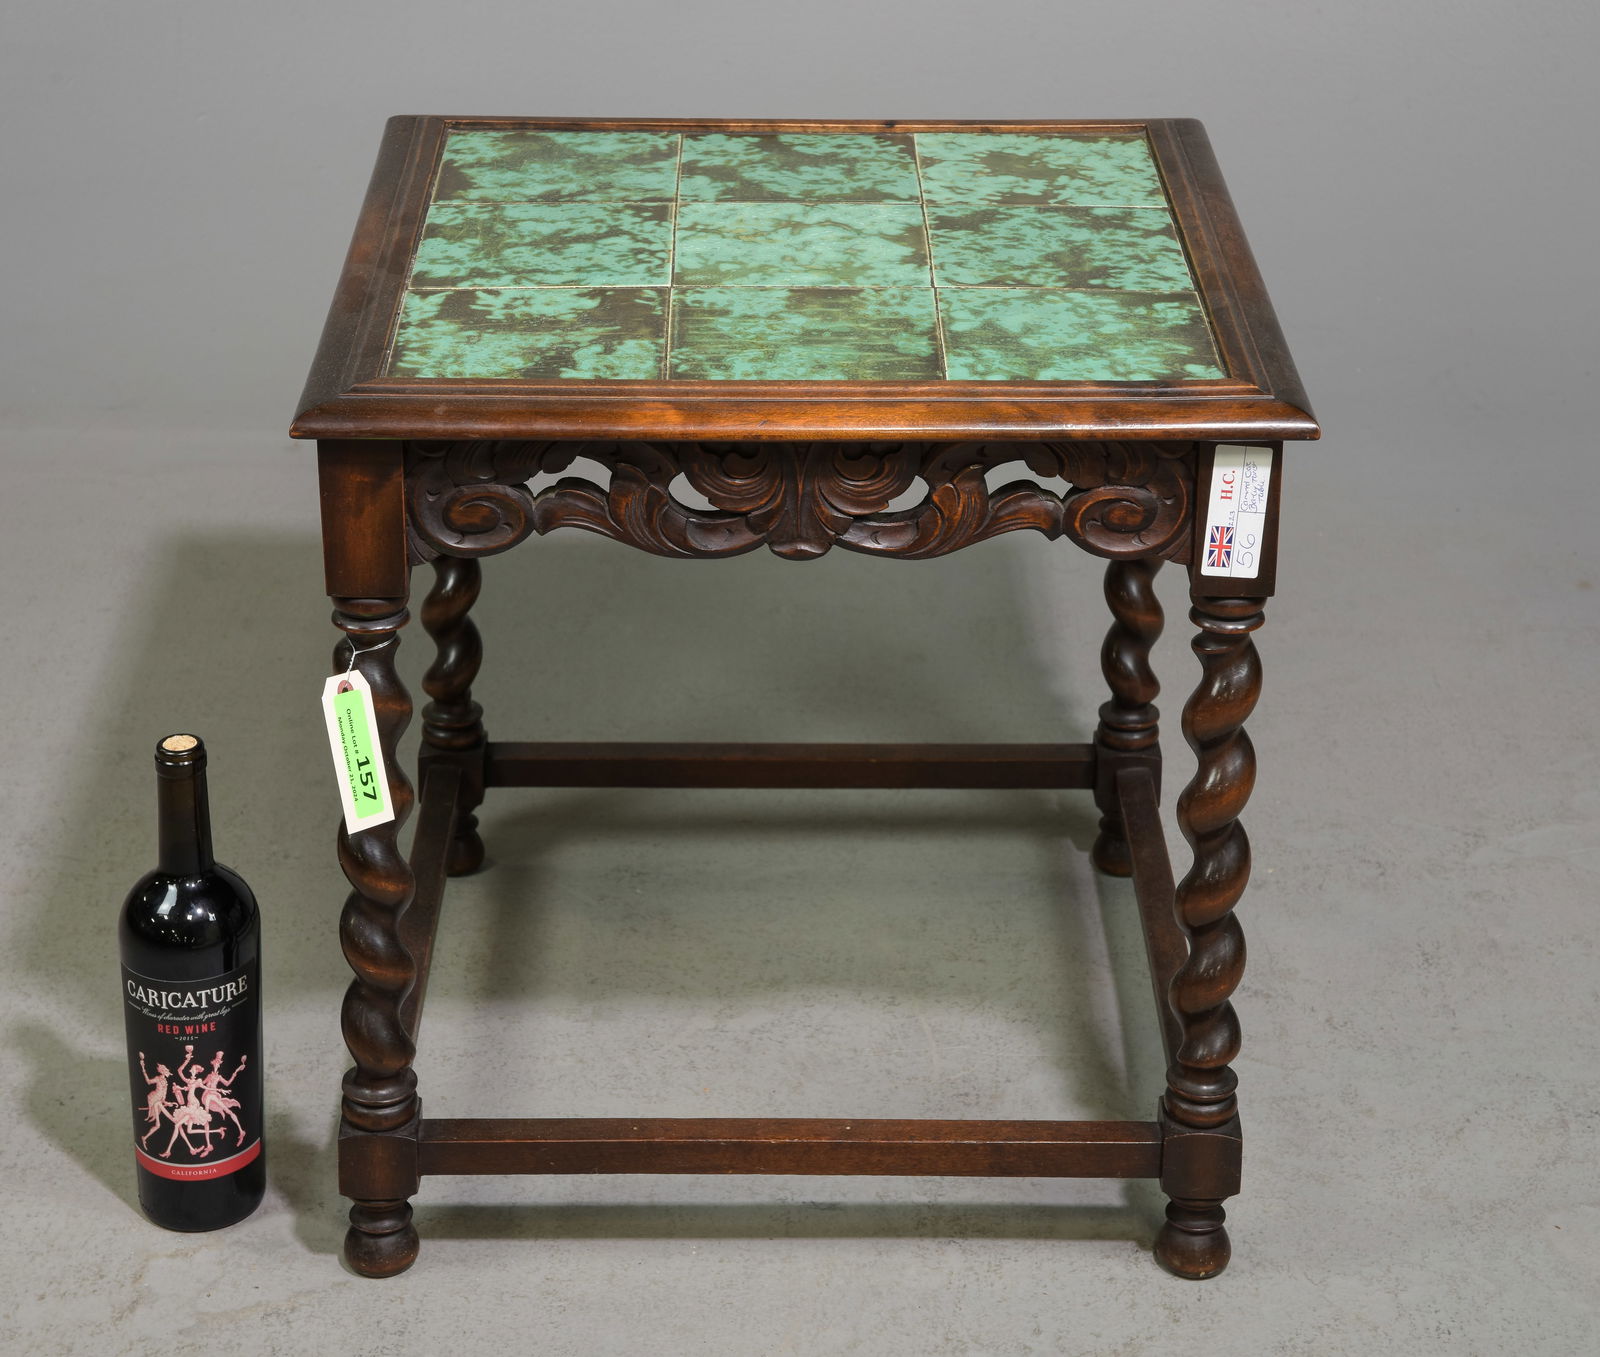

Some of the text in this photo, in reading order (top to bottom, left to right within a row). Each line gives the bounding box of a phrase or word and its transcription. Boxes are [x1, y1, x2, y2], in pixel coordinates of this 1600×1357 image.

[1220, 470, 1236, 500] H.C.
[1236, 533, 1256, 568] 56
[337, 716, 347, 746] Monday
[344, 745, 352, 772] October
[351, 784, 359, 802] 2024
[346, 708, 356, 735] Online
[356, 755, 378, 801] 157
[127, 975, 248, 1010] CARICATURE
[141, 1006, 231, 1021] Wines of character with great legs
[157, 1021, 217, 1034] RED WINE
[171, 1168, 217, 1176] CALIFORNIA
